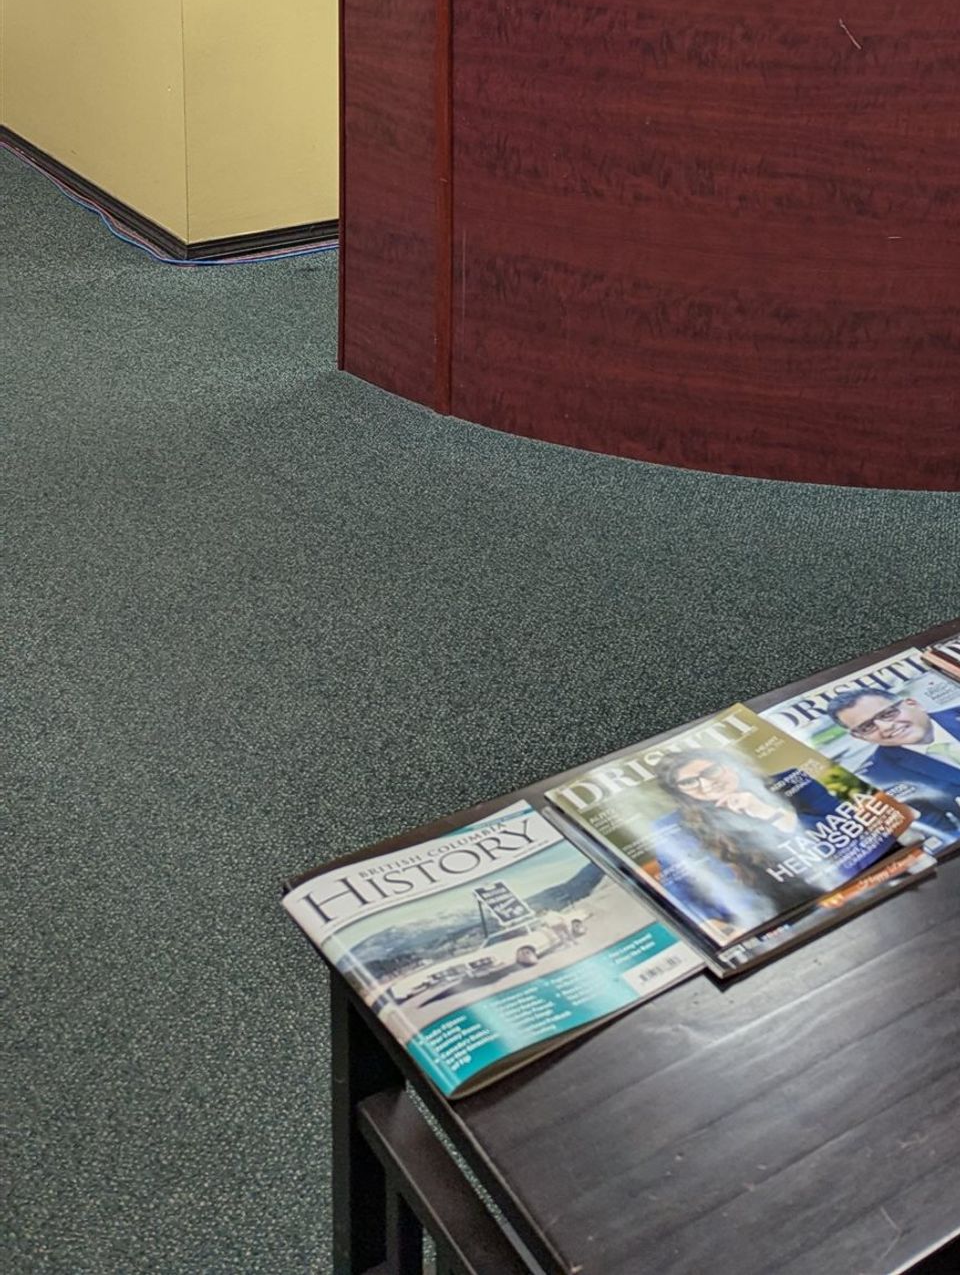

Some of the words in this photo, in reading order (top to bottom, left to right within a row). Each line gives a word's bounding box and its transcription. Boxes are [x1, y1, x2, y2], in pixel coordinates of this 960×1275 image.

[357, 855, 423, 879] BRITISH
[427, 823, 507, 858] COLUMBIA
[765, 794, 888, 883] HENDSBEE
[778, 791, 874, 856] TAMARA
